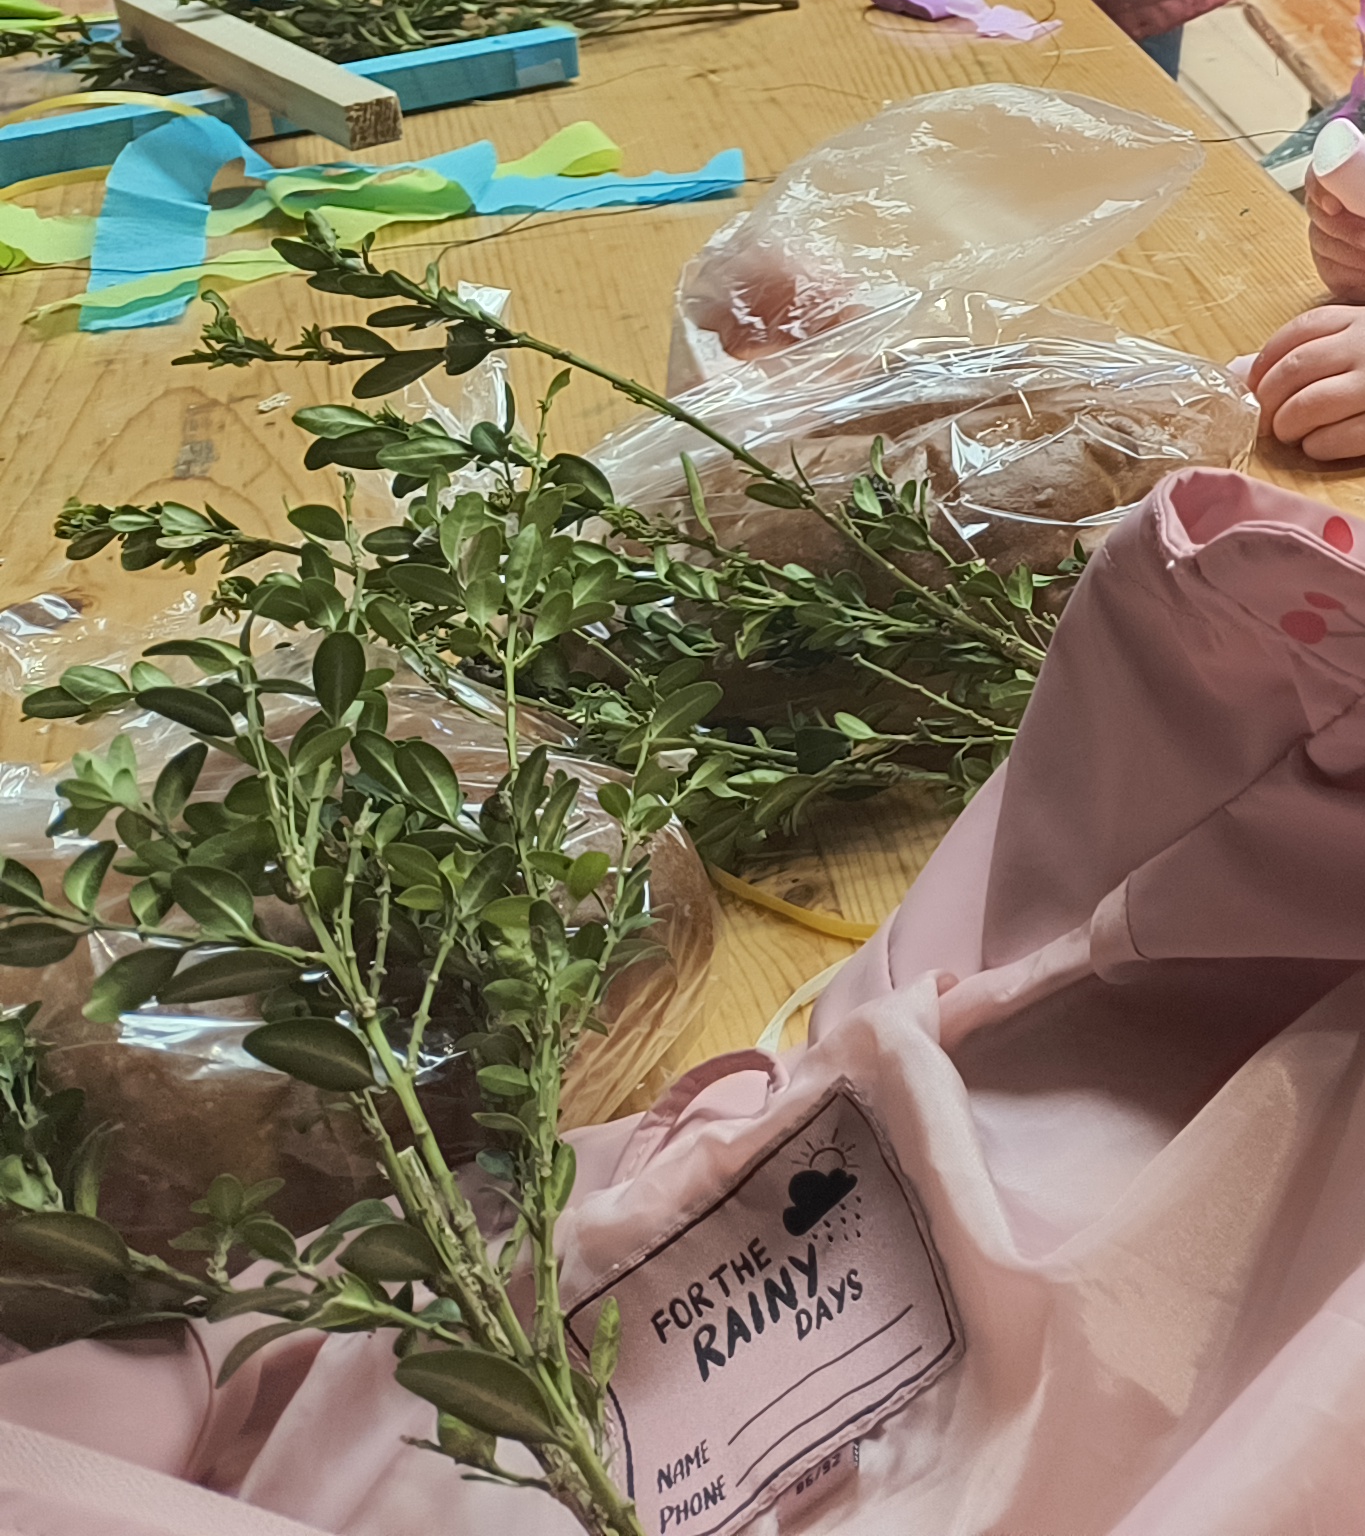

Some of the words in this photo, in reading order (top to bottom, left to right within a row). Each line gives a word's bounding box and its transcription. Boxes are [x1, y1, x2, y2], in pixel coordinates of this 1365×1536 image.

[651, 1282, 715, 1344] FOR
[709, 1237, 772, 1298] THE
[693, 1242, 818, 1382] RAINY
[795, 1269, 863, 1341] DAYS
[657, 1438, 710, 1494] NAME
[660, 1474, 726, 1534] PHONE
